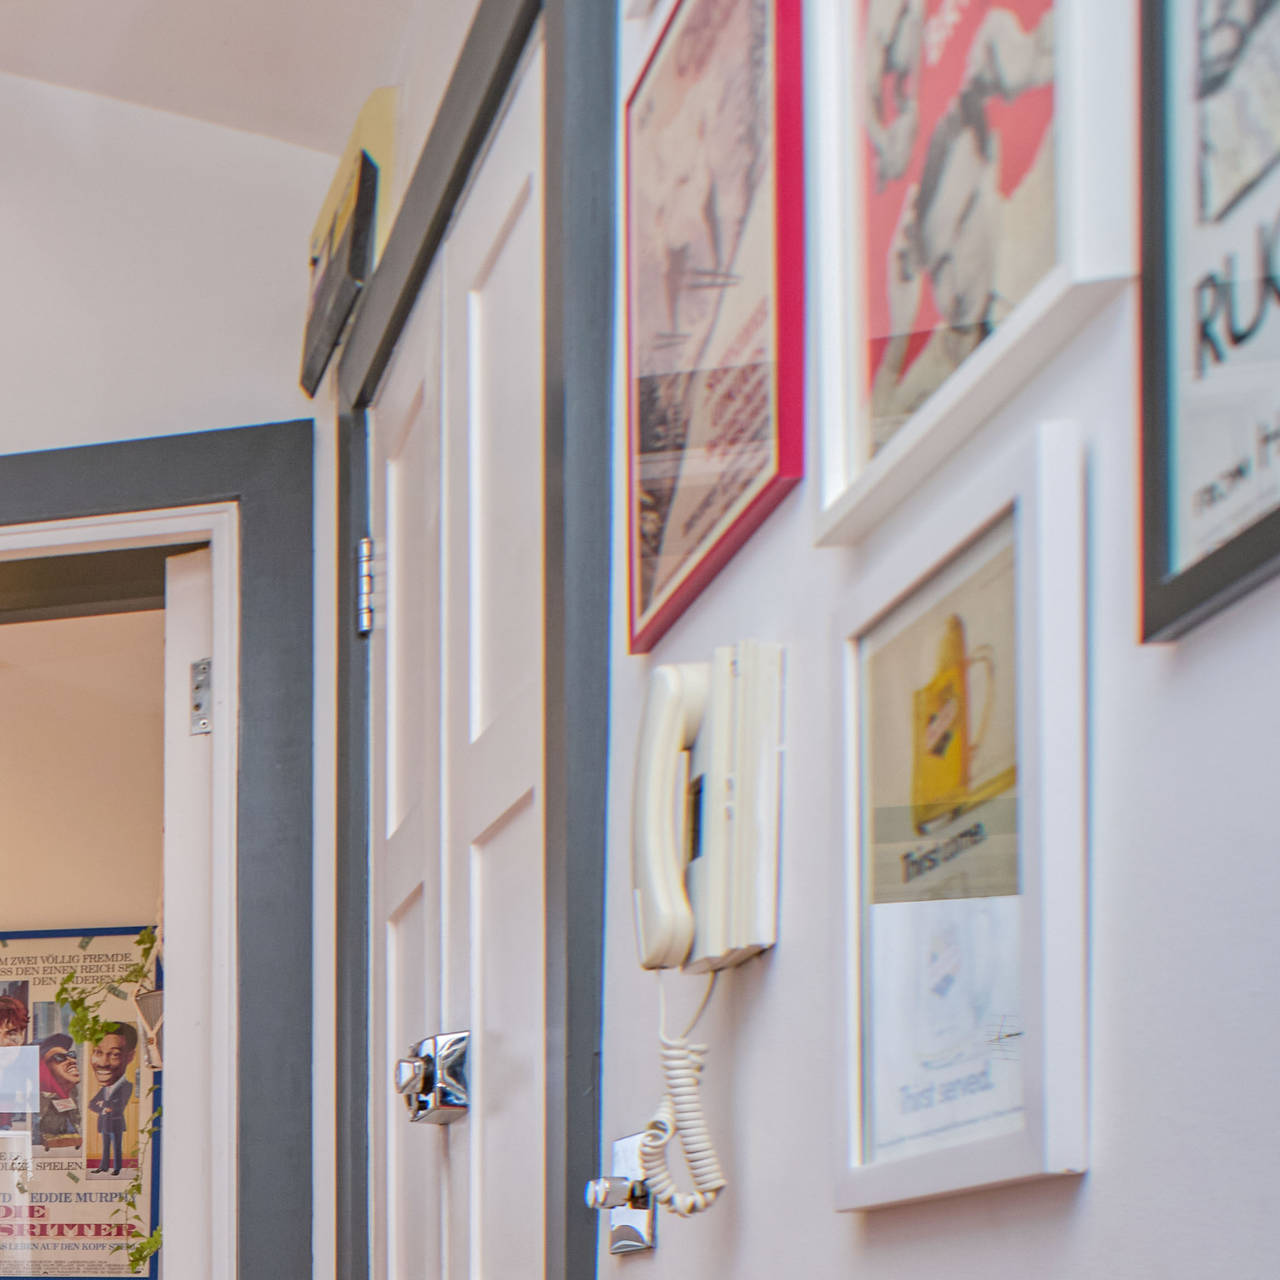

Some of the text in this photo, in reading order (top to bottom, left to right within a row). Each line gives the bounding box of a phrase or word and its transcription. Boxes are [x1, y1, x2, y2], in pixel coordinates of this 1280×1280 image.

[10, 956, 38, 966] ZWEI
[40, 954, 78, 965] VÖLLIG
[16, 966, 39, 976] DEN
[42, 965, 75, 975] EINEN
[80, 963, 116, 974] REICH
[32, 977, 57, 986] DEN
[30, 1192, 72, 1203] EDDIE
